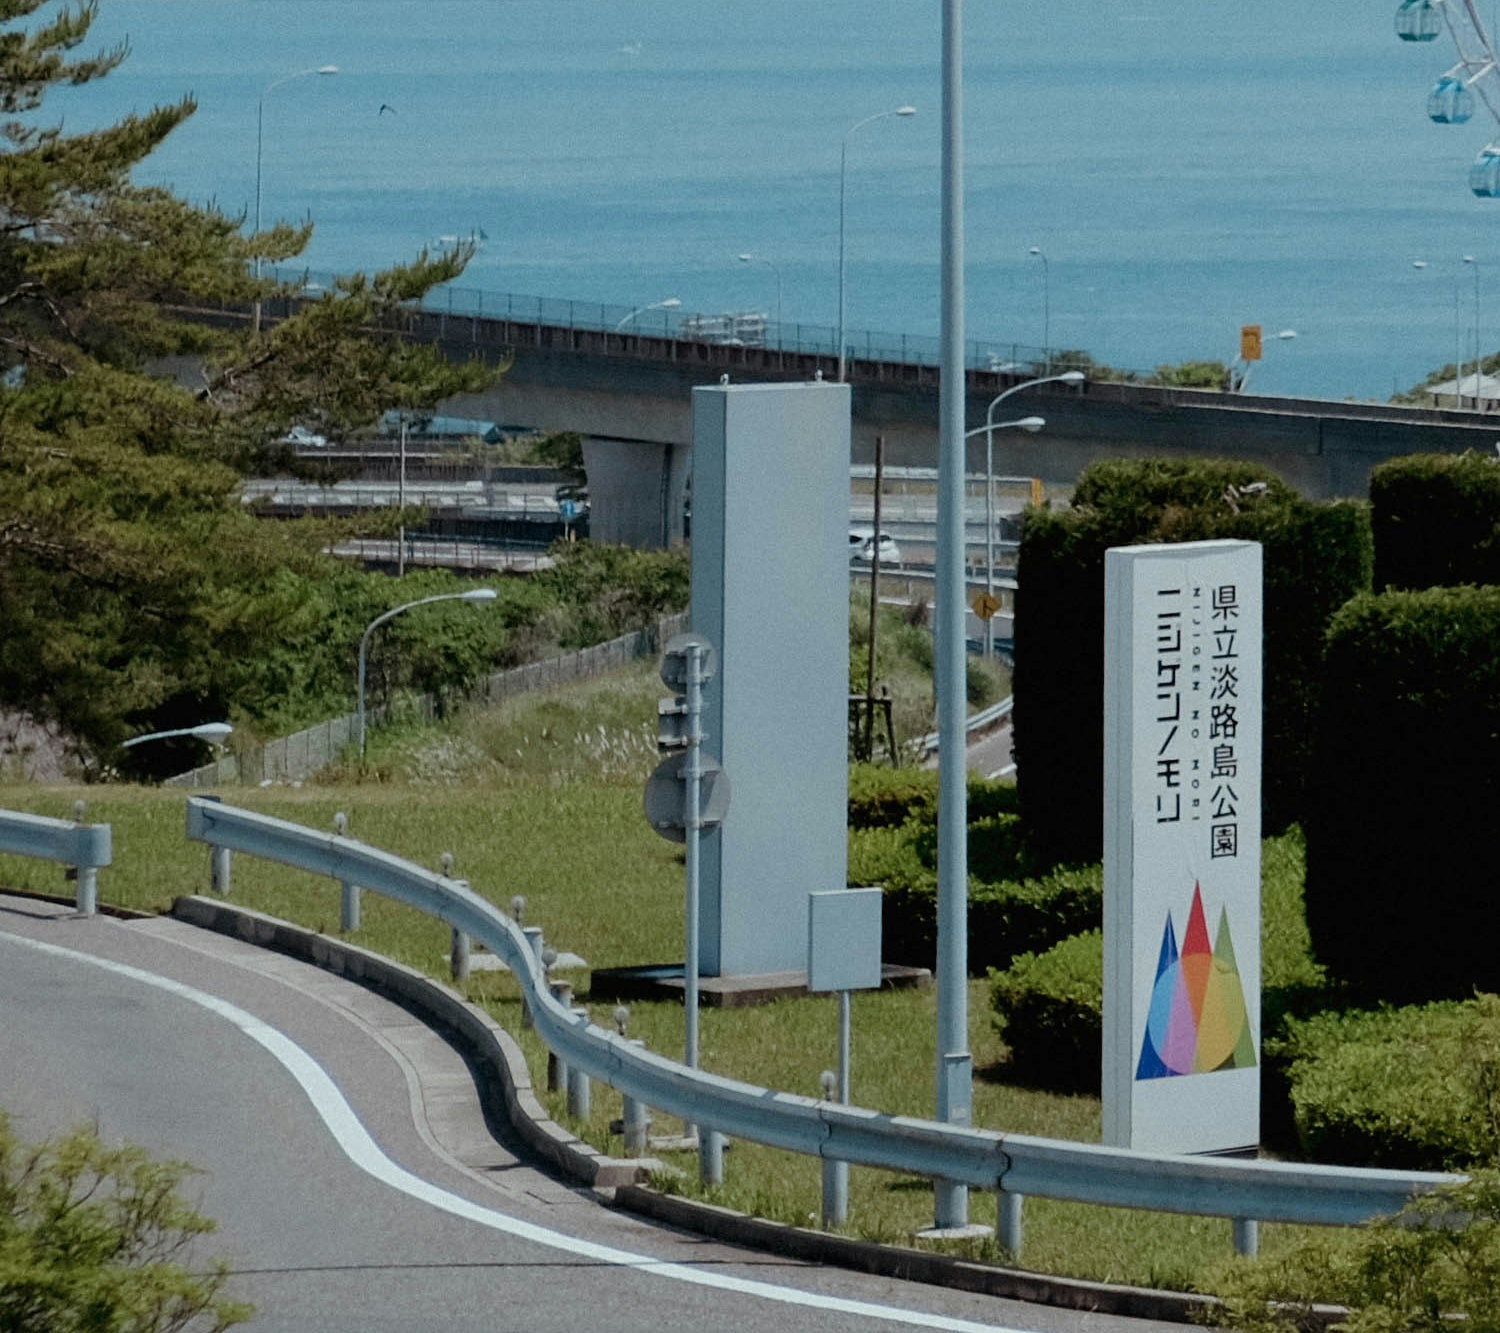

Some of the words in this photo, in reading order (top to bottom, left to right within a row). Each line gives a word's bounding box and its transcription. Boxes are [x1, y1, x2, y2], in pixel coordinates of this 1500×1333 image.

[1209, 584, 1239, 859] 県立淡路島公園
